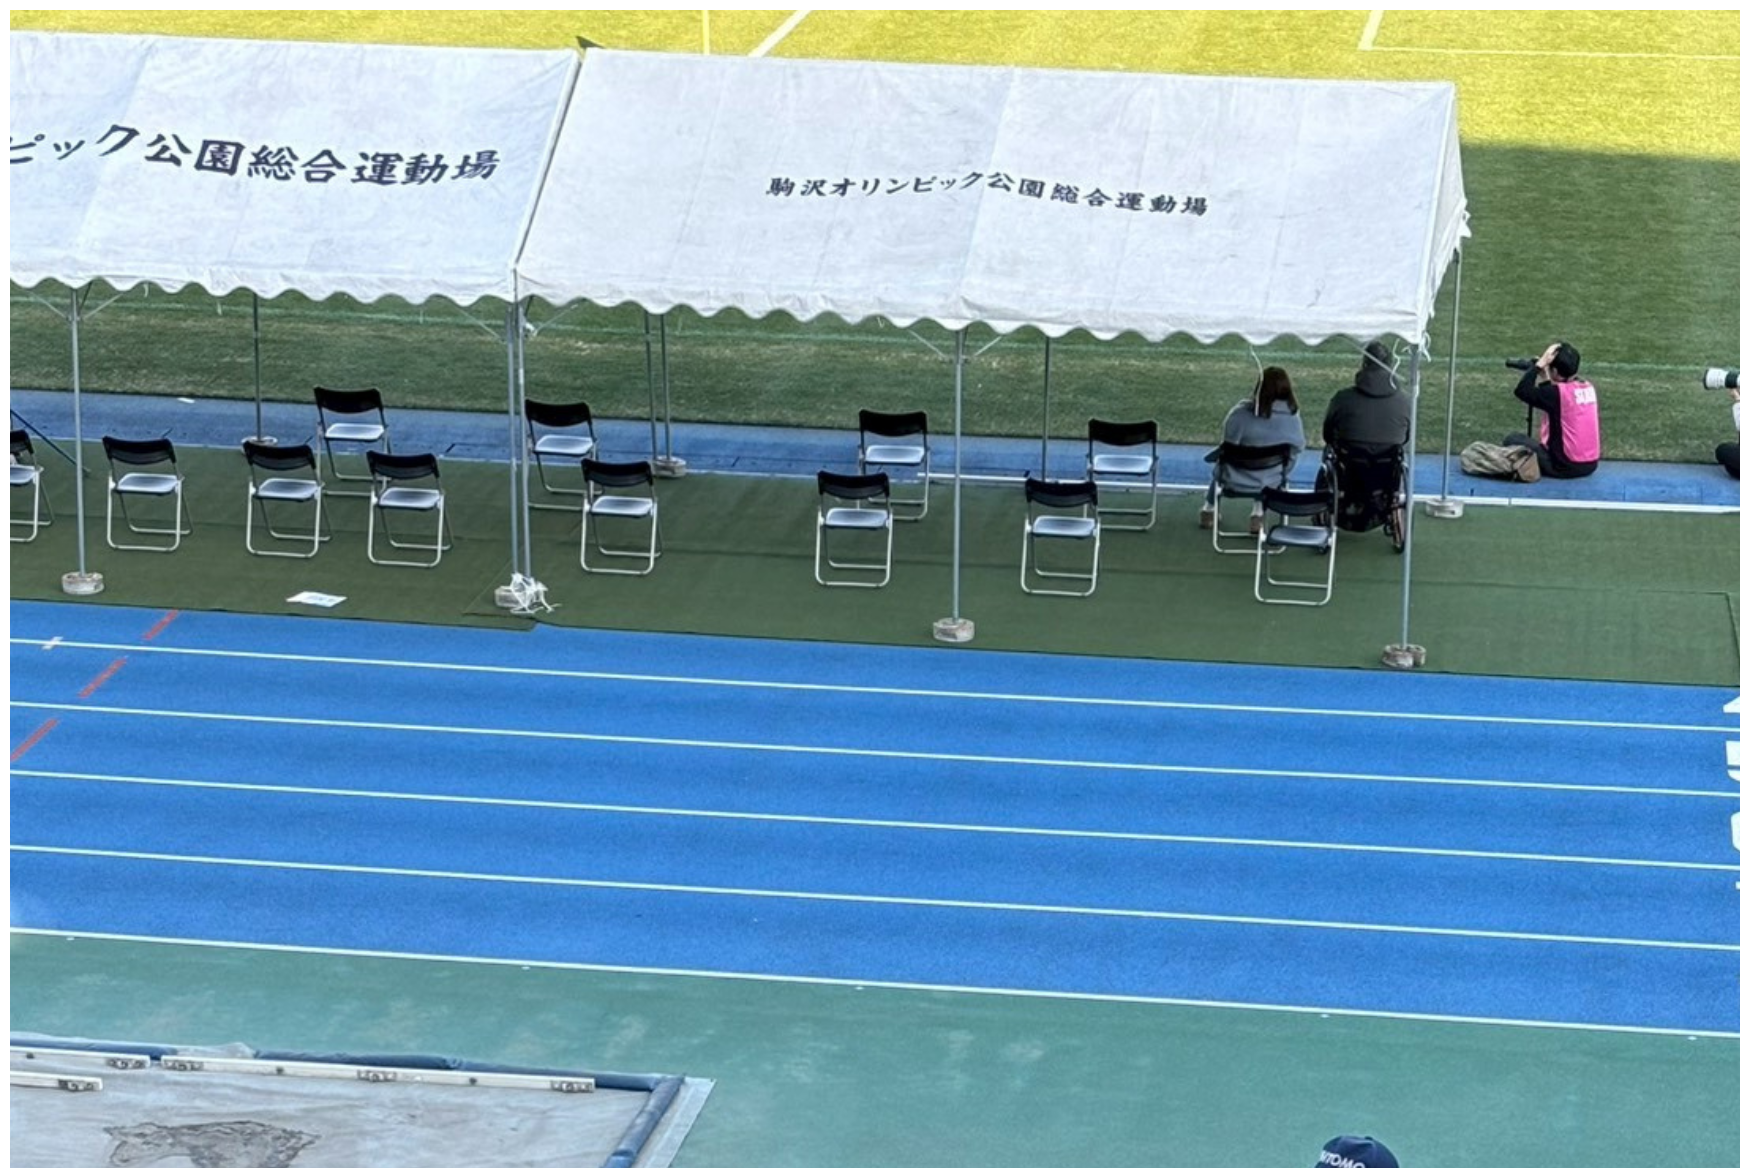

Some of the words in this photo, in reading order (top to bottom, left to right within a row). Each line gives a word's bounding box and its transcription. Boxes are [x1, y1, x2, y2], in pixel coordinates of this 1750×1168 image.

[766, 171, 1208, 217] 駒沢オリンピック公園総合運動場
